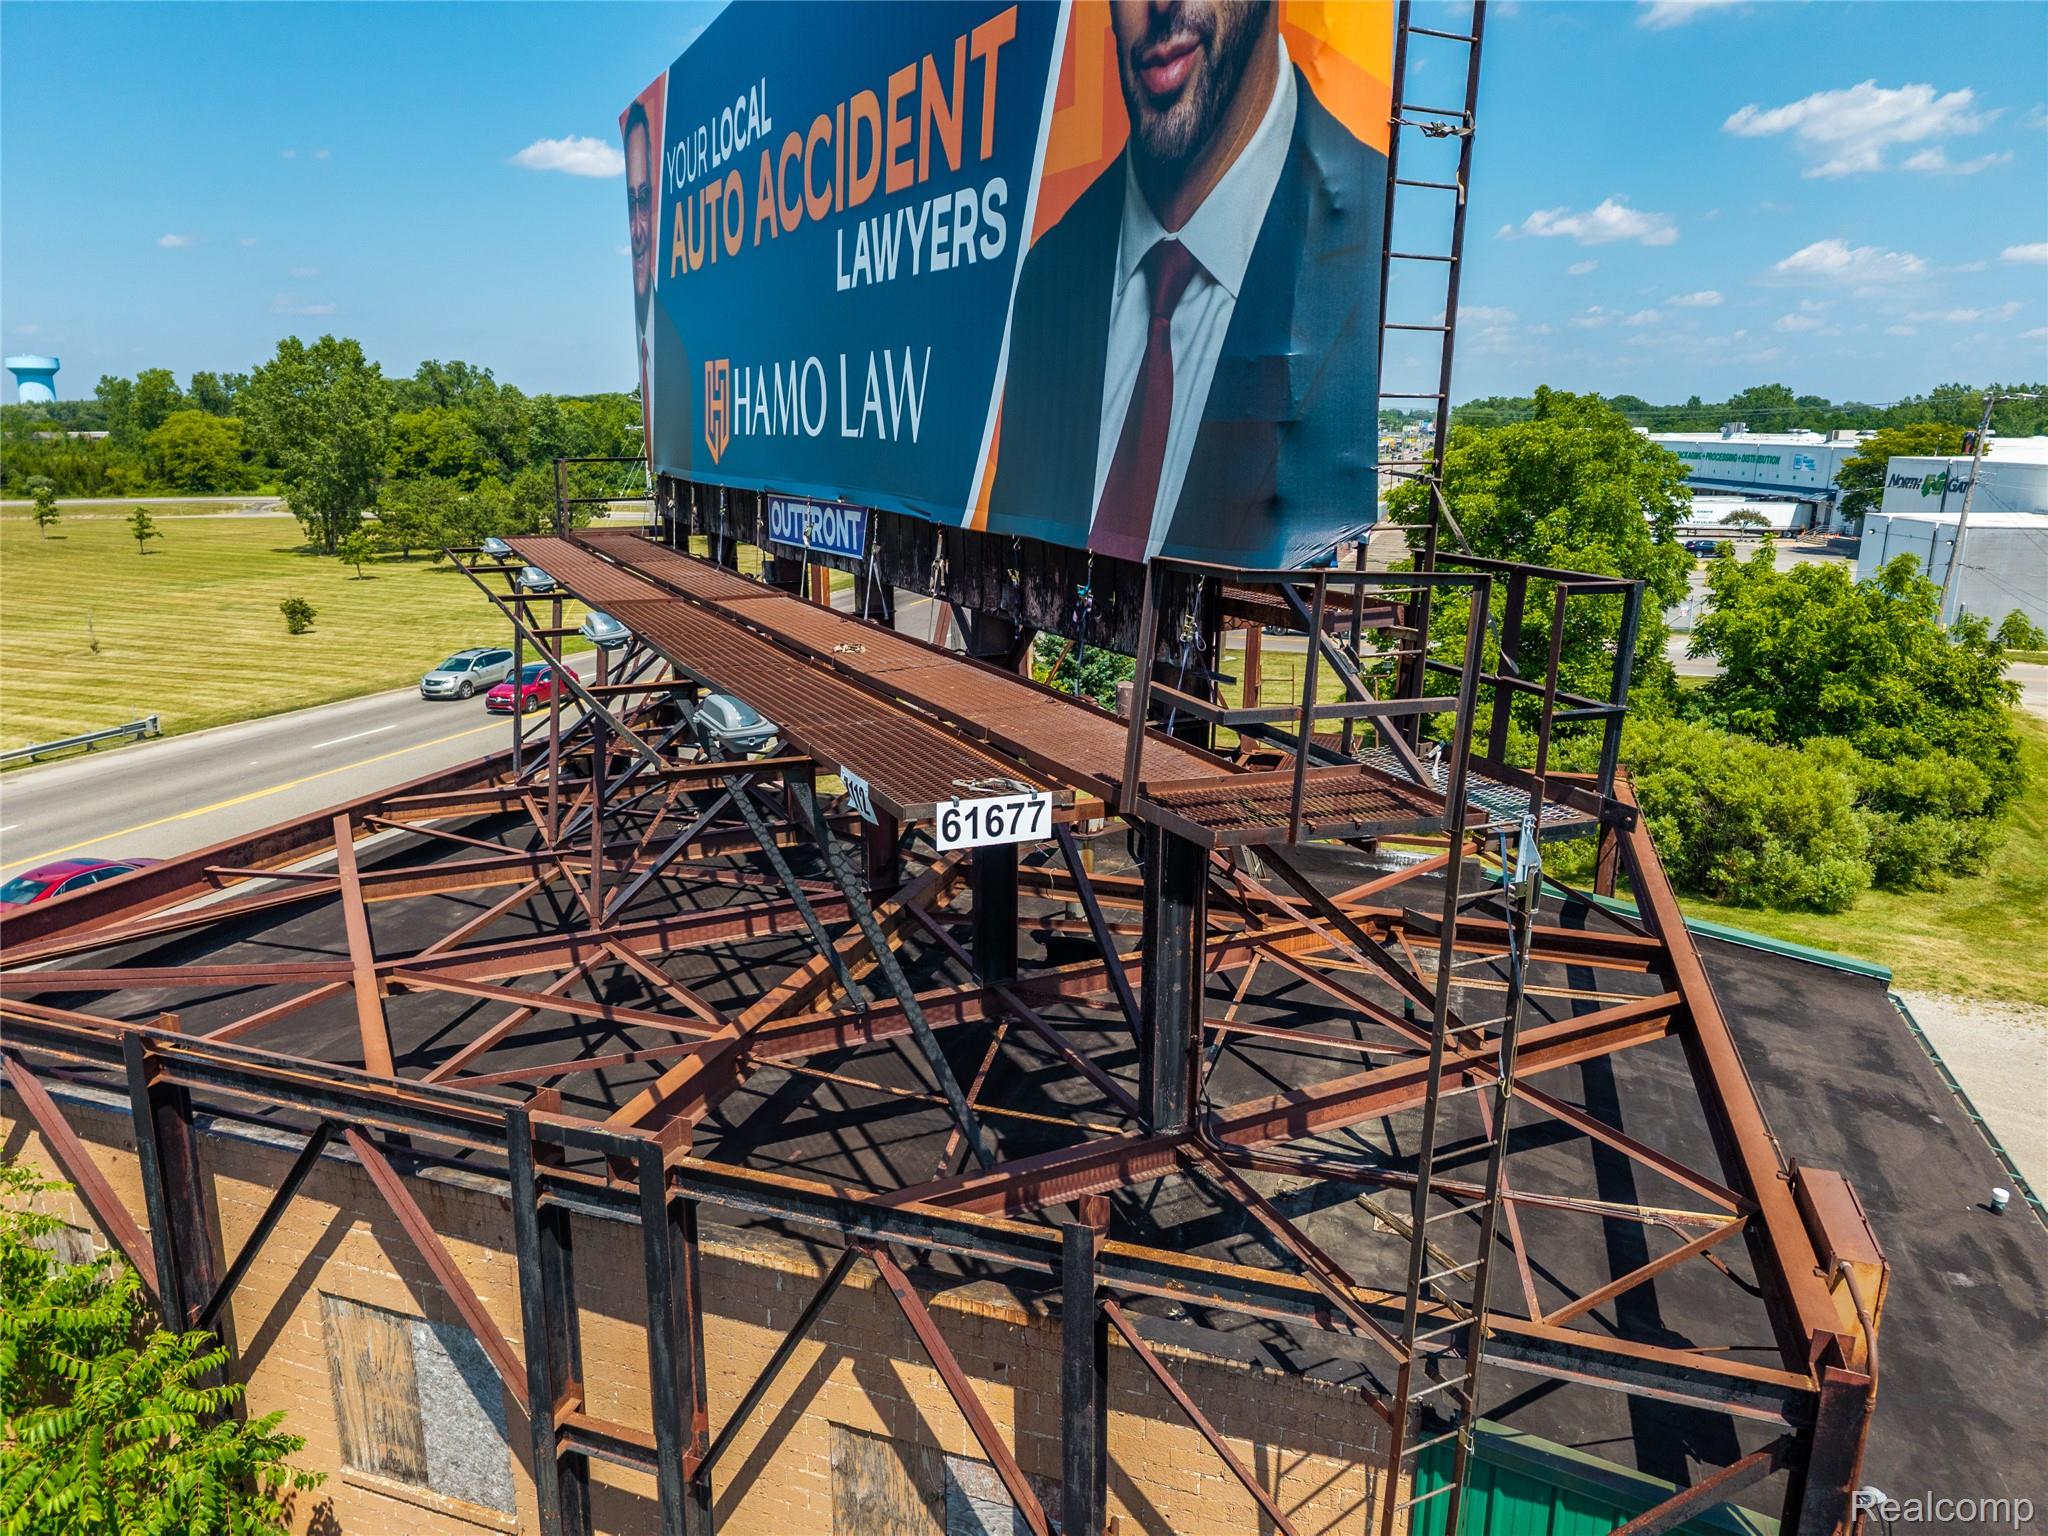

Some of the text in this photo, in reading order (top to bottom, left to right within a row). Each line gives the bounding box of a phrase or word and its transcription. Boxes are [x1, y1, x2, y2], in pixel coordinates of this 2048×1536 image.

[667, 77, 772, 194] YOUR LOCAL
[670, 4, 1018, 279] AUTO ACCIDENT
[836, 176, 1008, 292] LAWYERS
[734, 345, 931, 444] HAMO LAW
[1741, 453, 1781, 465] DISTRIBUTION
[1947, 478, 1975, 494] GAT
[771, 500, 862, 551] OUTFRONT
[941, 800, 1046, 843] 61677
